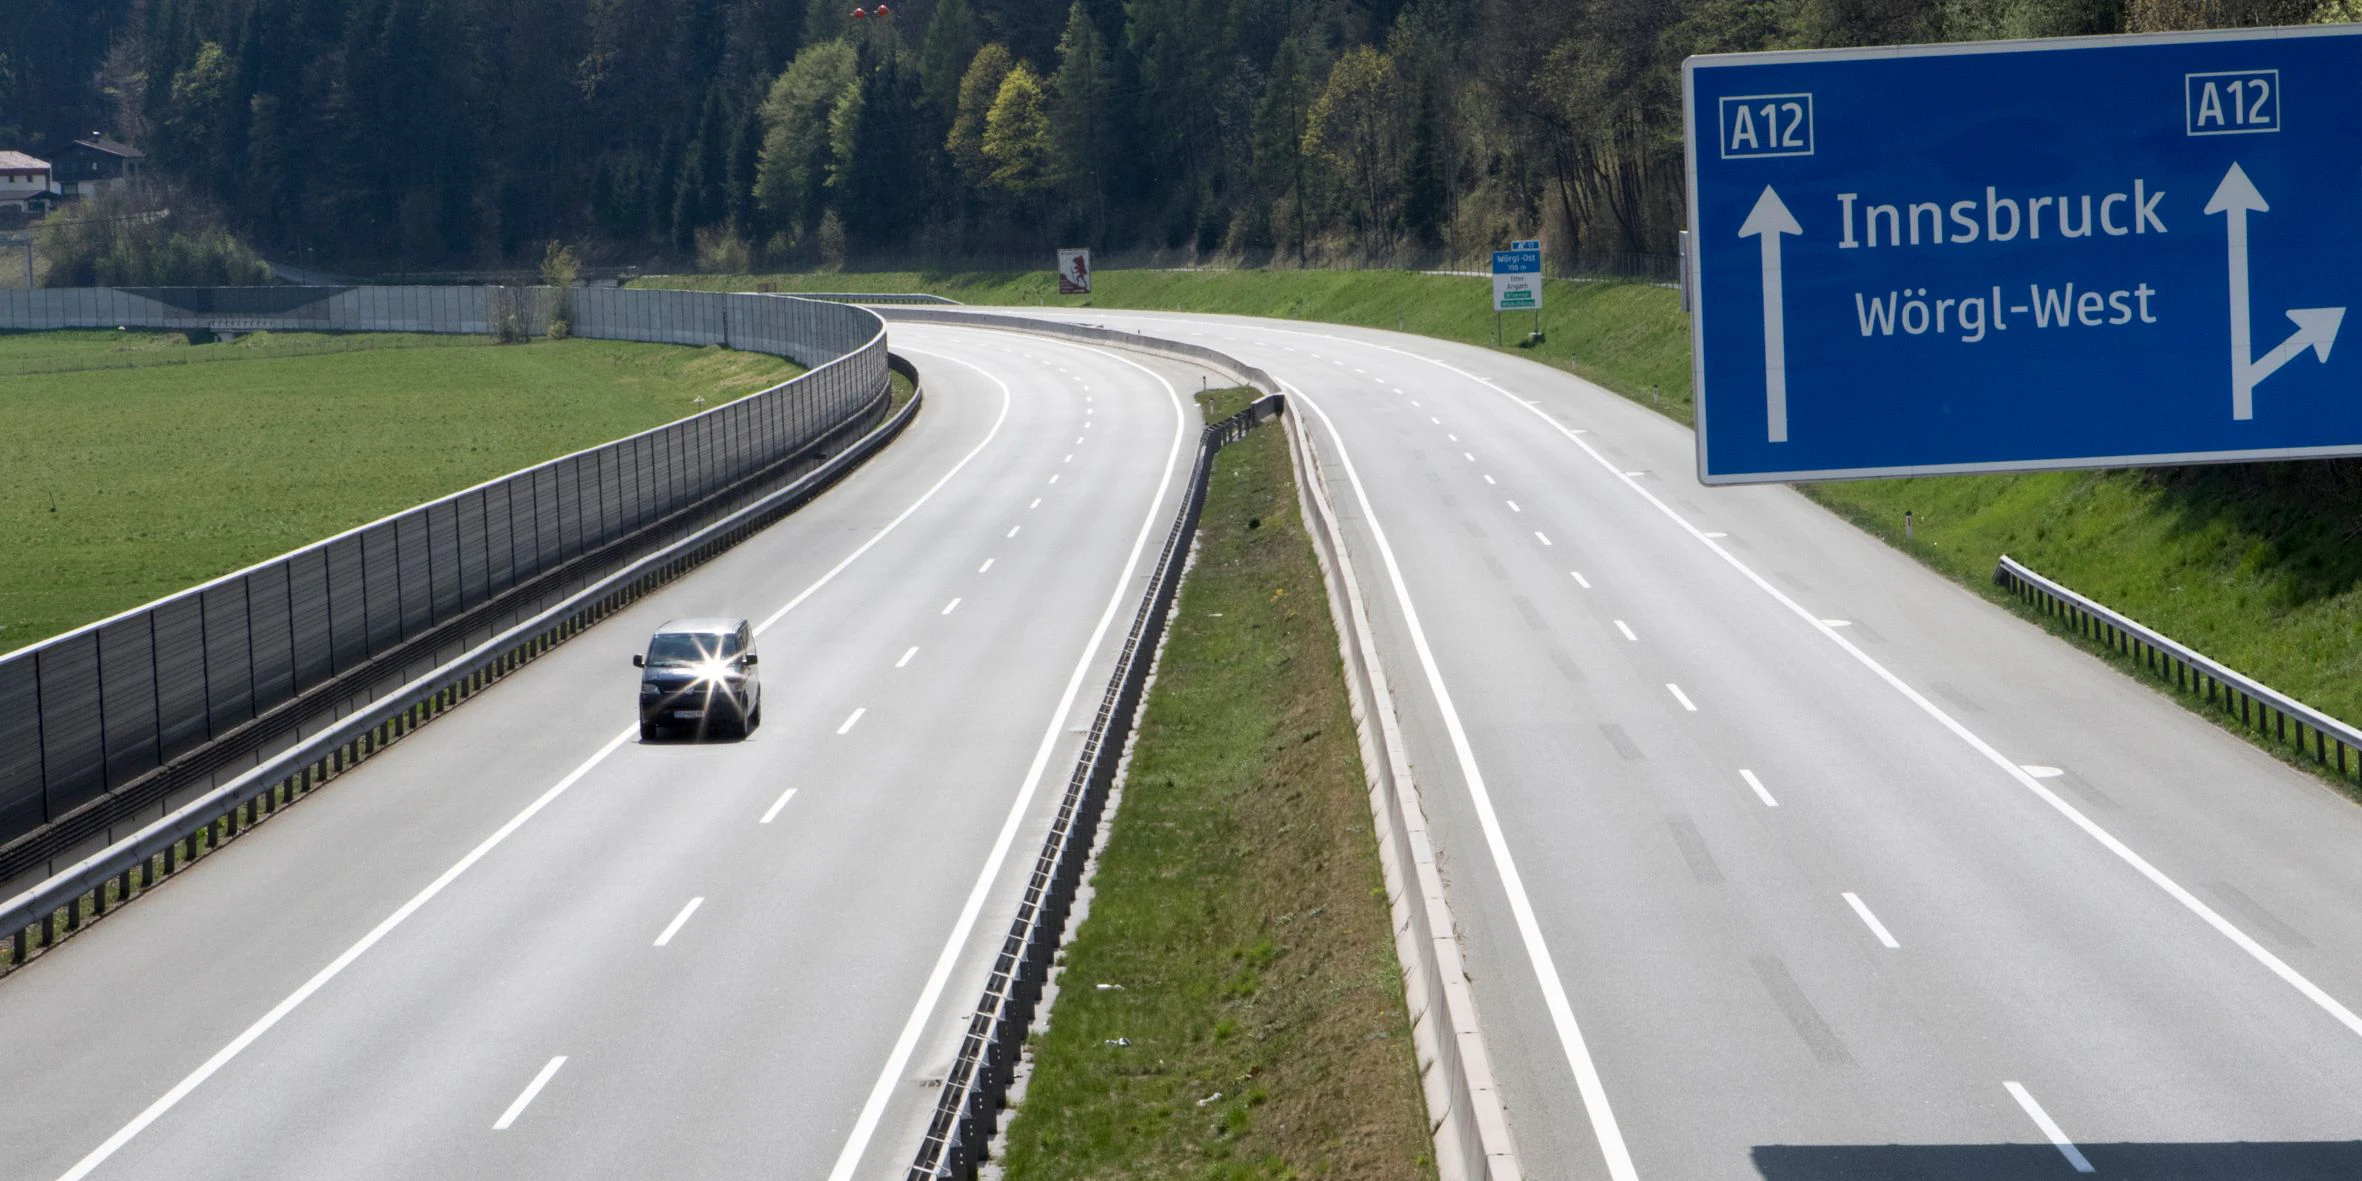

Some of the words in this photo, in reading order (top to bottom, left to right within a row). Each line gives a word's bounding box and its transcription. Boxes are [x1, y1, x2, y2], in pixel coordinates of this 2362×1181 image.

[1731, 101, 1804, 150] A12
[2197, 77, 2271, 126] A12
[1838, 179, 2167, 249] Innsbruck
[1855, 282, 2157, 343] Wörgl-West
